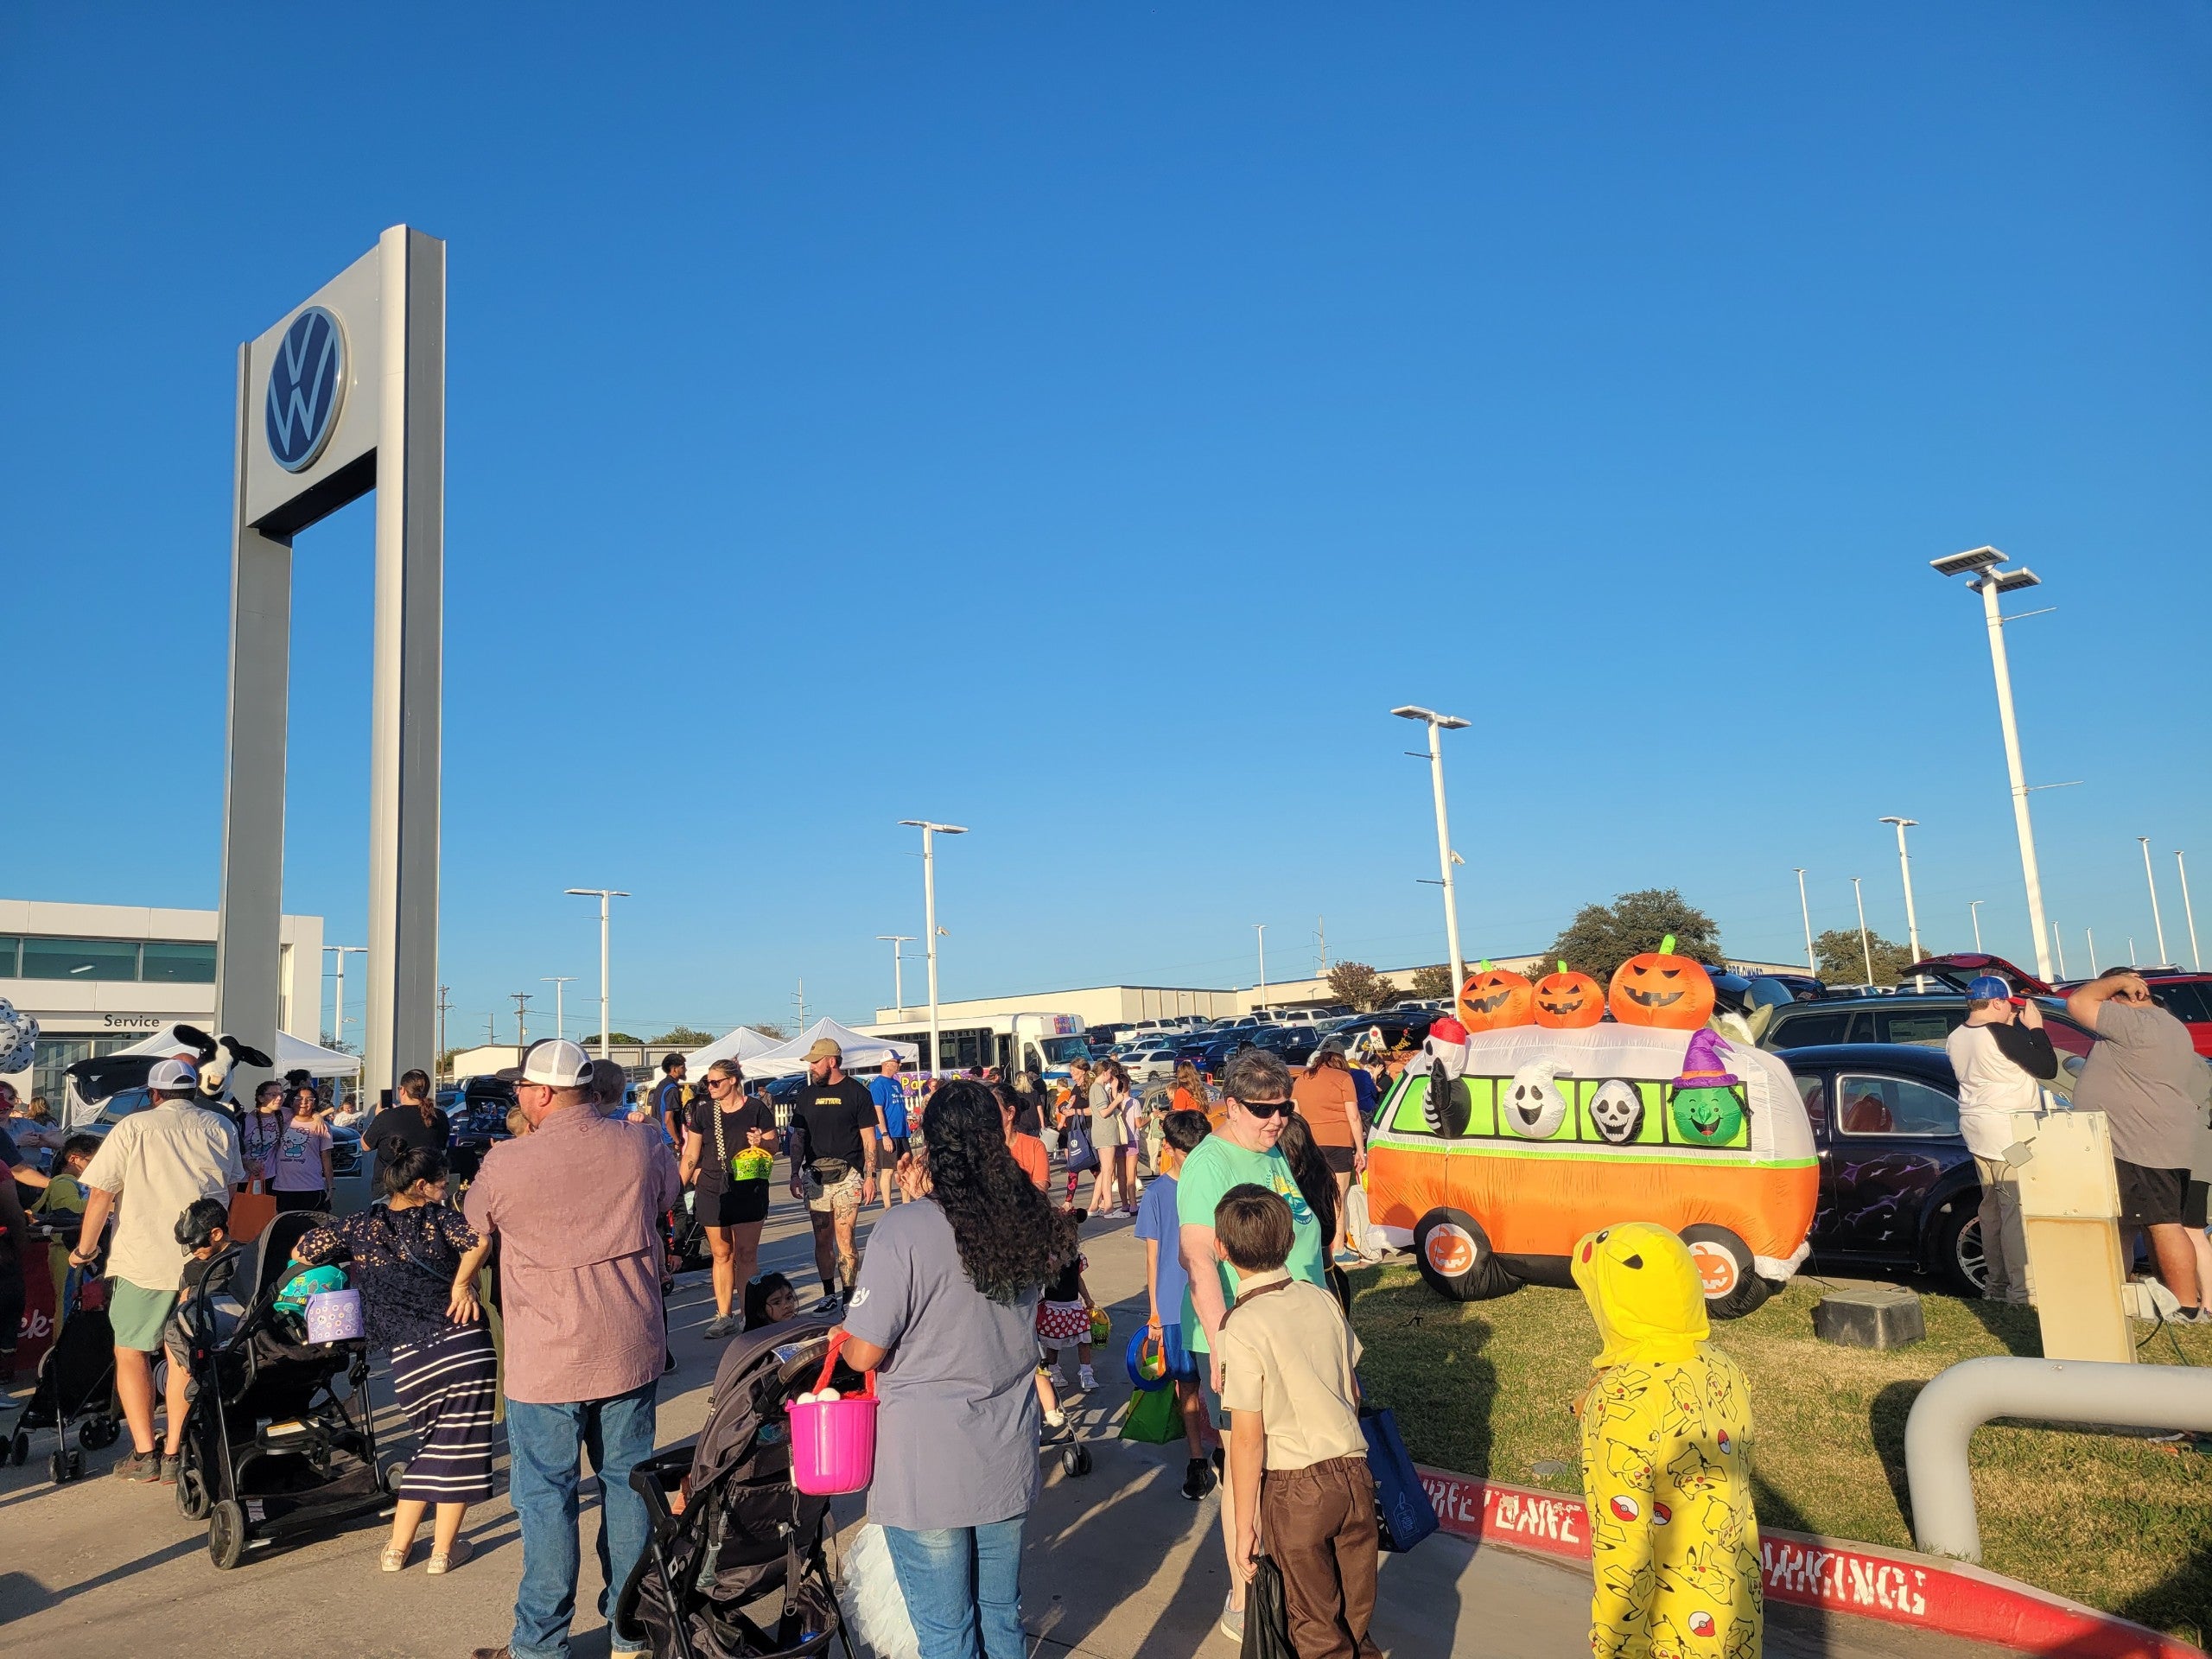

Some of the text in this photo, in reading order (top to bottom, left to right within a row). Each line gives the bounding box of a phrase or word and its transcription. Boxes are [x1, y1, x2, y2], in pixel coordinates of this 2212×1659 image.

[265, 310, 335, 456] VW
[104, 1014, 160, 1027] Service
[1759, 1541, 1927, 1616] ARKING
